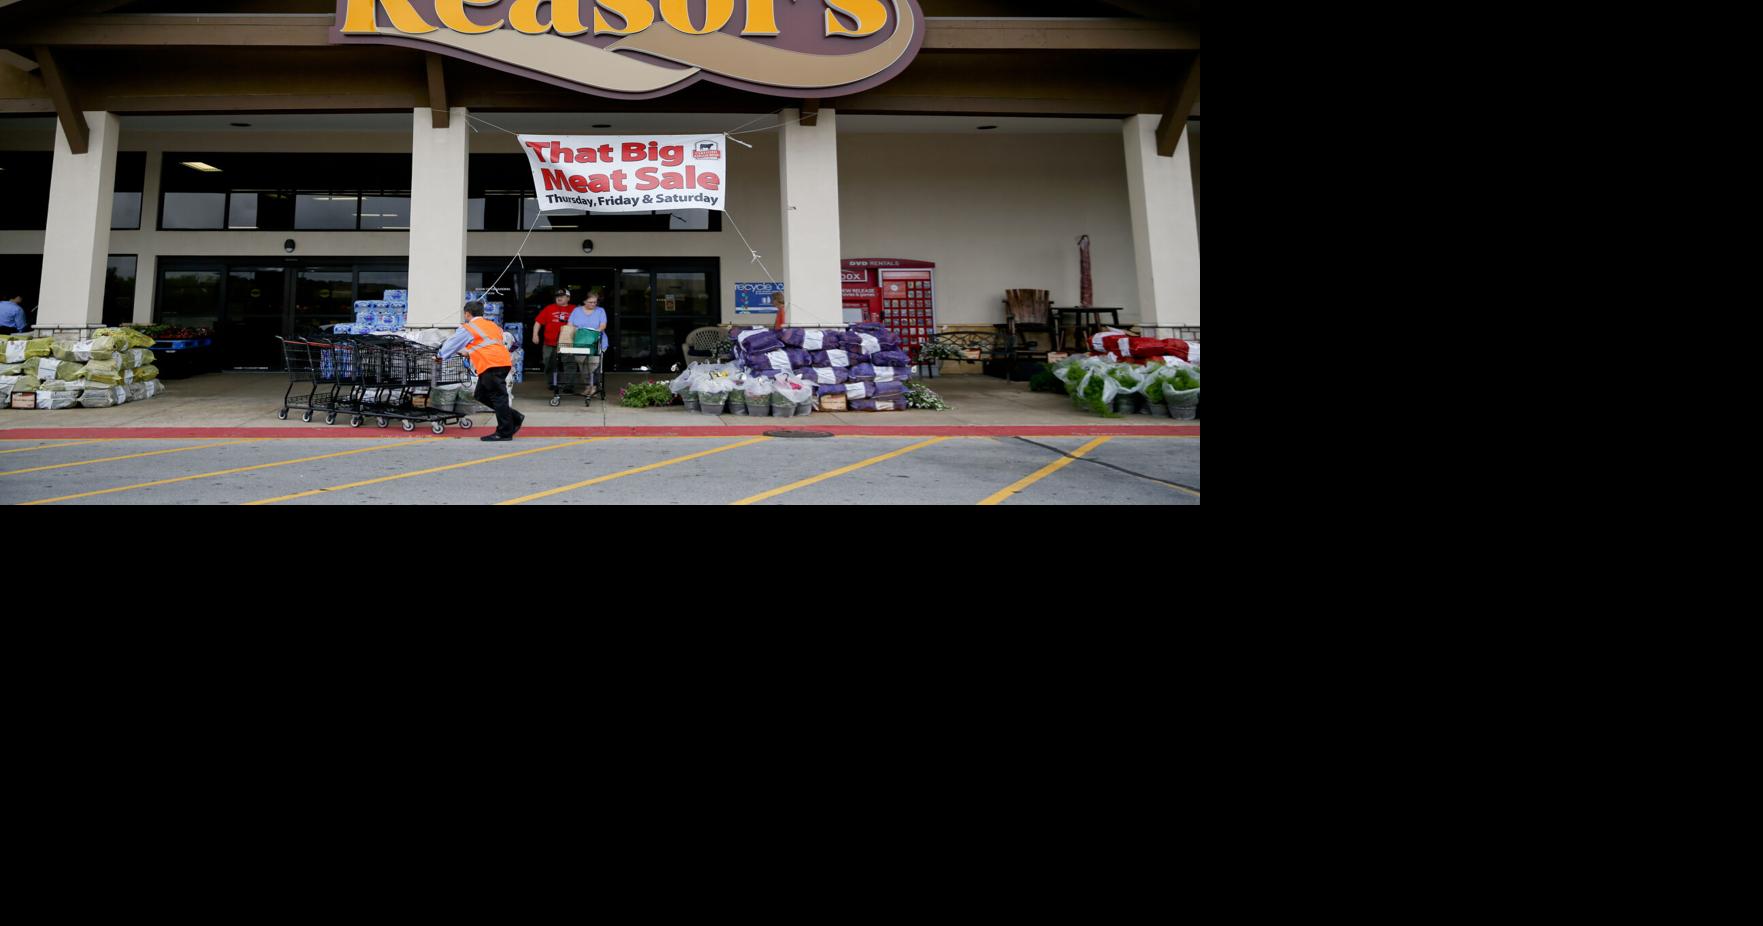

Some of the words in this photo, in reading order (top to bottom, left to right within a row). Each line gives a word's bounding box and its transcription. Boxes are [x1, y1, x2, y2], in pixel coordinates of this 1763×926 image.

[340, 0, 888, 37] easors
[525, 141, 614, 163] That
[621, 141, 684, 167] Big
[541, 168, 628, 193] Meat
[635, 165, 720, 191] Sale
[546, 194, 597, 207] Thursday,
[597, 195, 639, 207] Friday
[642, 194, 653, 204] &
[655, 193, 718, 206] Saturday
[735, 282, 772, 294] recycle
